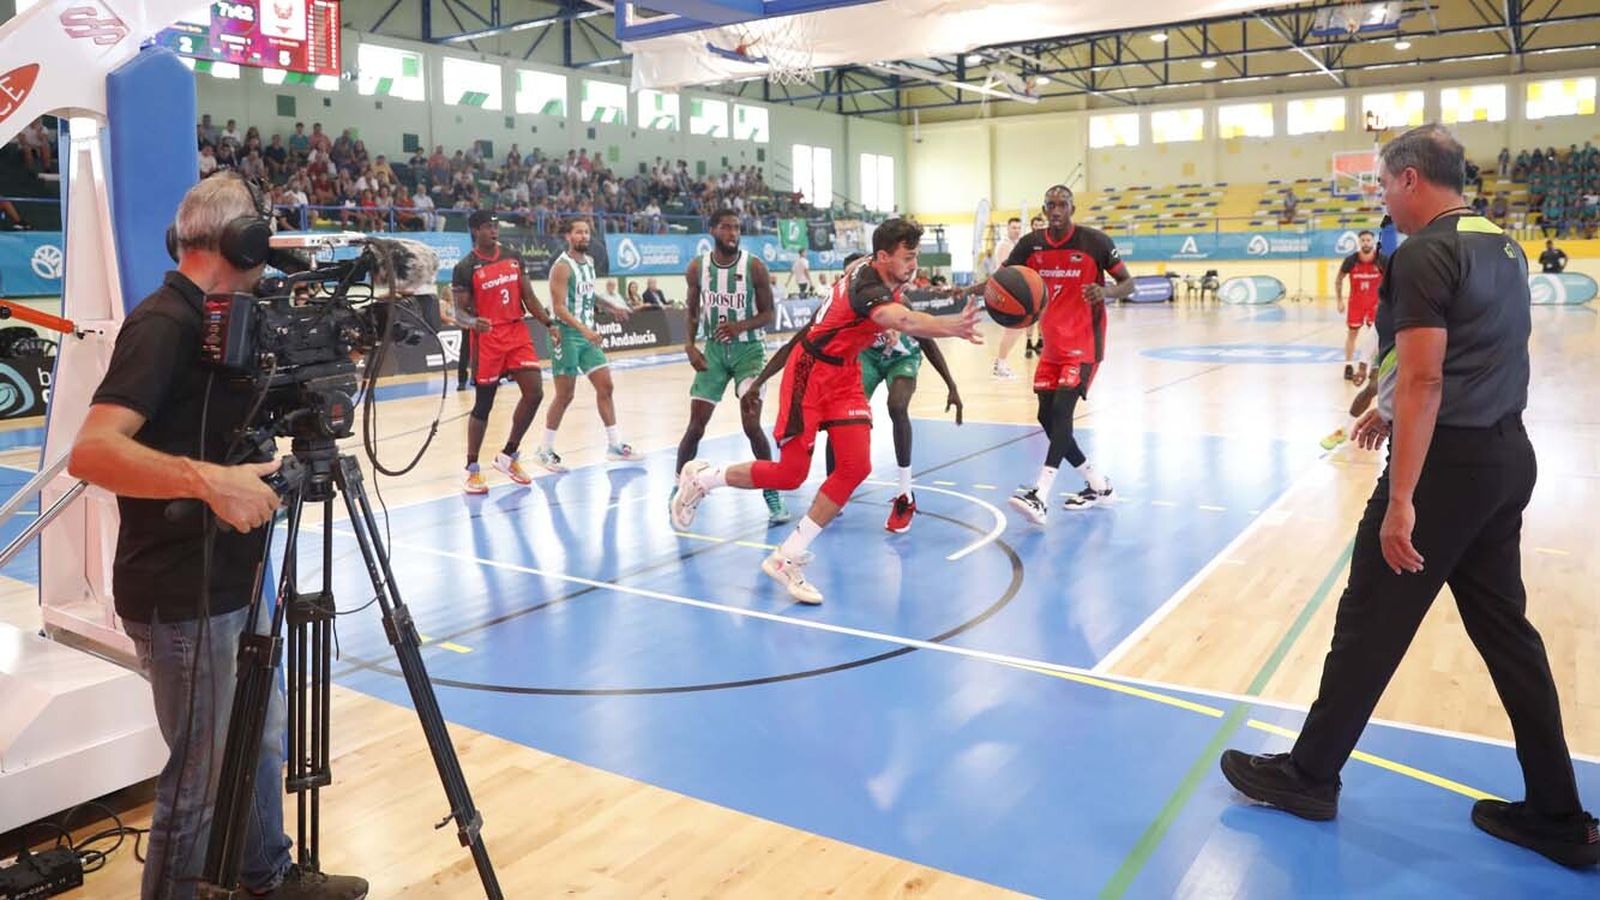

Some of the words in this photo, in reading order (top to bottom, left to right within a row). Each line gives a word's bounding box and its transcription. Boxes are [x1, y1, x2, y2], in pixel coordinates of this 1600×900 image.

[178, 36, 193, 53] 2
[500, 289, 510, 304] 3
[1052, 285, 1063, 301] 7
[595, 322, 622, 334] Junta
